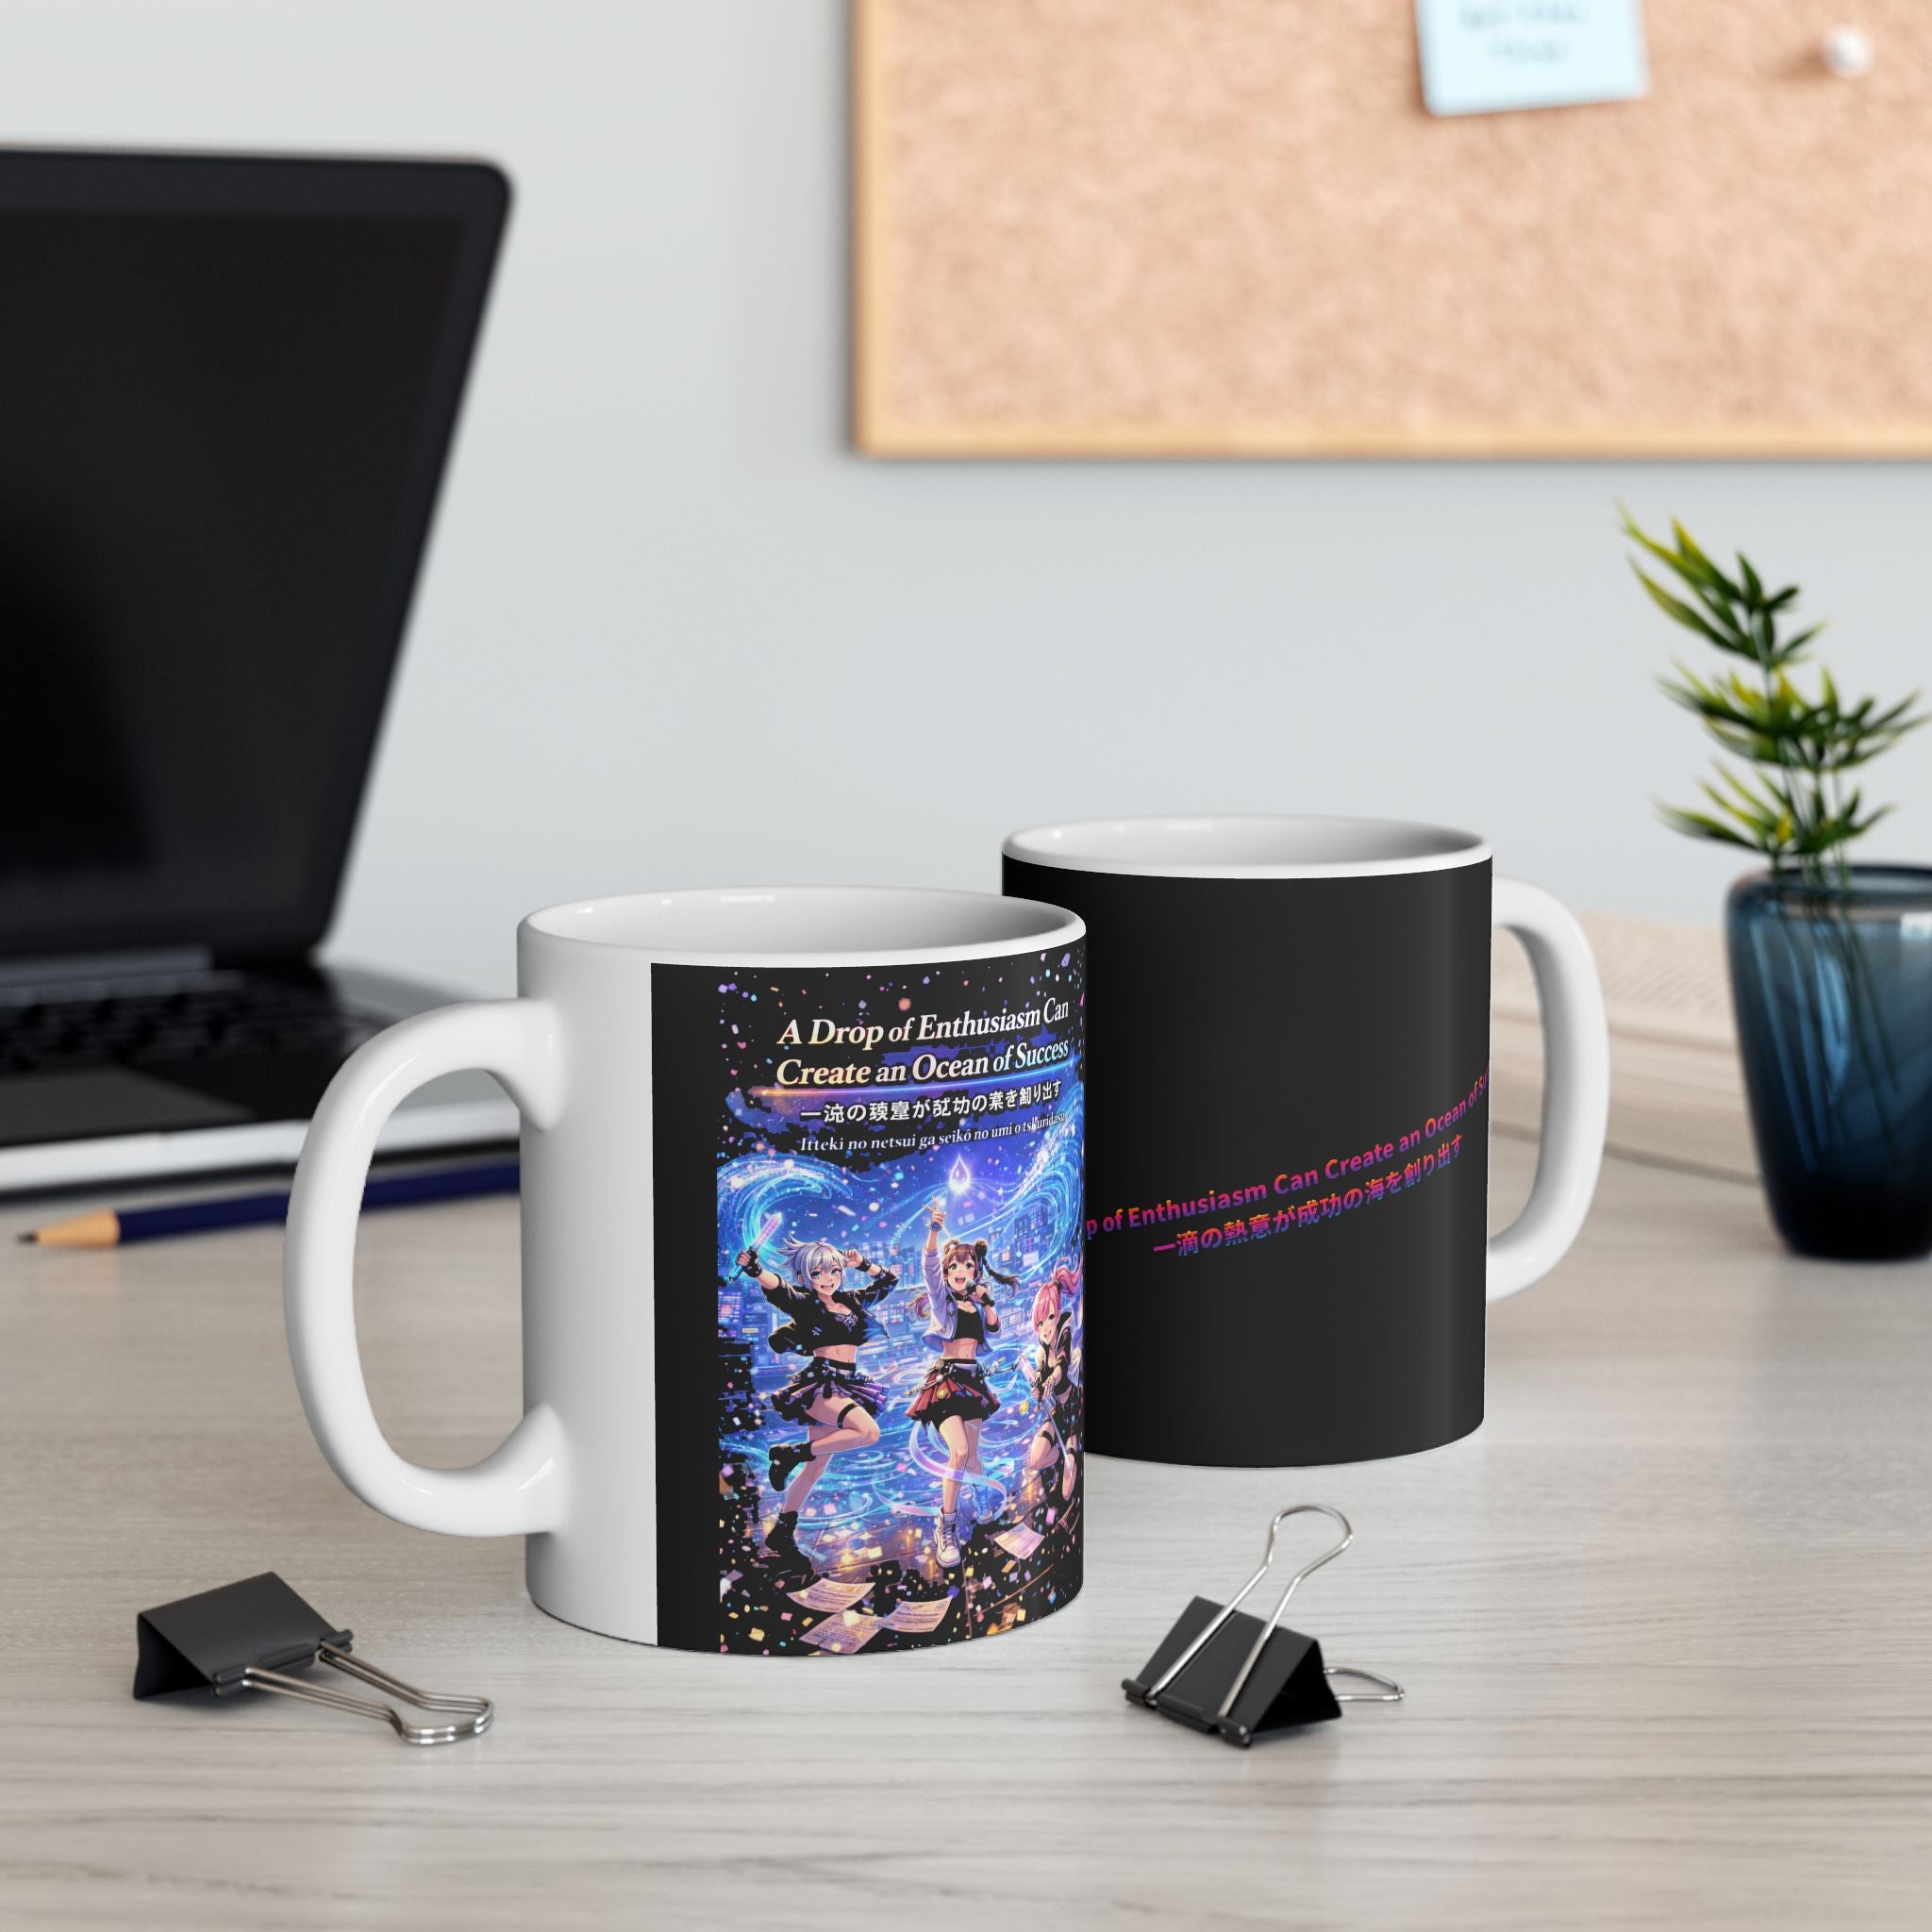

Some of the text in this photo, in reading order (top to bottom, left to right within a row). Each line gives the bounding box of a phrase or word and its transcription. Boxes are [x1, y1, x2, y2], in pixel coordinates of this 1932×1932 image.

[776, 997, 1069, 1051] A Drop of Enthusiasm Can
[776, 1042, 1069, 1085] Create an Ocean of Success
[848, 1139, 867, 1150] no
[871, 1134, 916, 1149] netsui
[919, 1136, 936, 1150] ga
[974, 1131, 989, 1140] no
[991, 1124, 1012, 1137] umi
[1014, 1124, 1021, 1133] o
[1103, 1208, 1124, 1232] of
[1128, 1190, 1268, 1227] Enthusiasm
[1274, 1169, 1319, 1194] Can
[1324, 1142, 1393, 1179] Create
[1399, 1129, 1421, 1152] an
[1424, 1099, 1466, 1138] Ocean
[1468, 1080, 1478, 1108] of
[1153, 1134, 1462, 1256] 一滴の熱意が成功の海を創り出す
